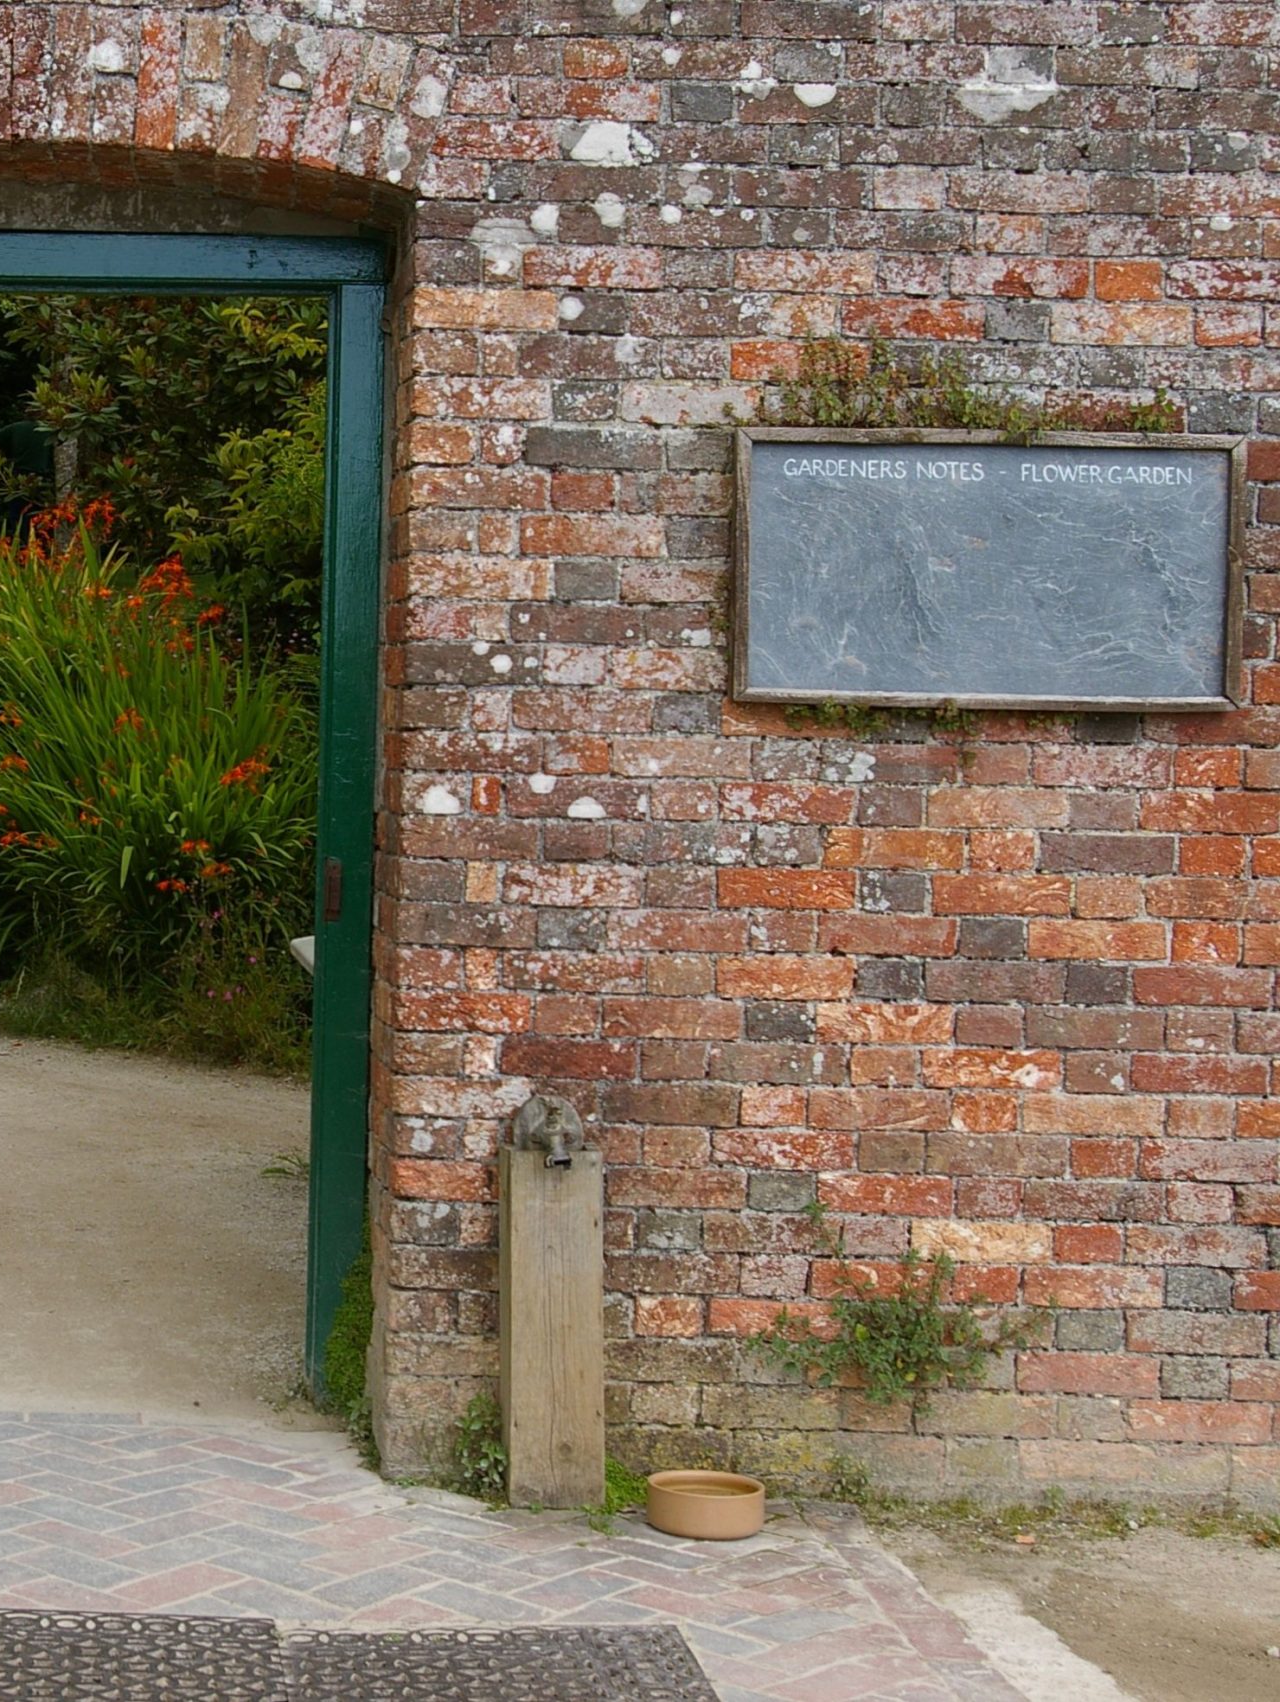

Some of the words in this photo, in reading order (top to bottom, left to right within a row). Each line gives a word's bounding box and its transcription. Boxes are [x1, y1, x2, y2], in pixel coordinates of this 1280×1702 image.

[916, 460, 985, 482] NOTES
[1020, 463, 1103, 484] FLOWER
[1107, 465, 1192, 485] GARDEN
